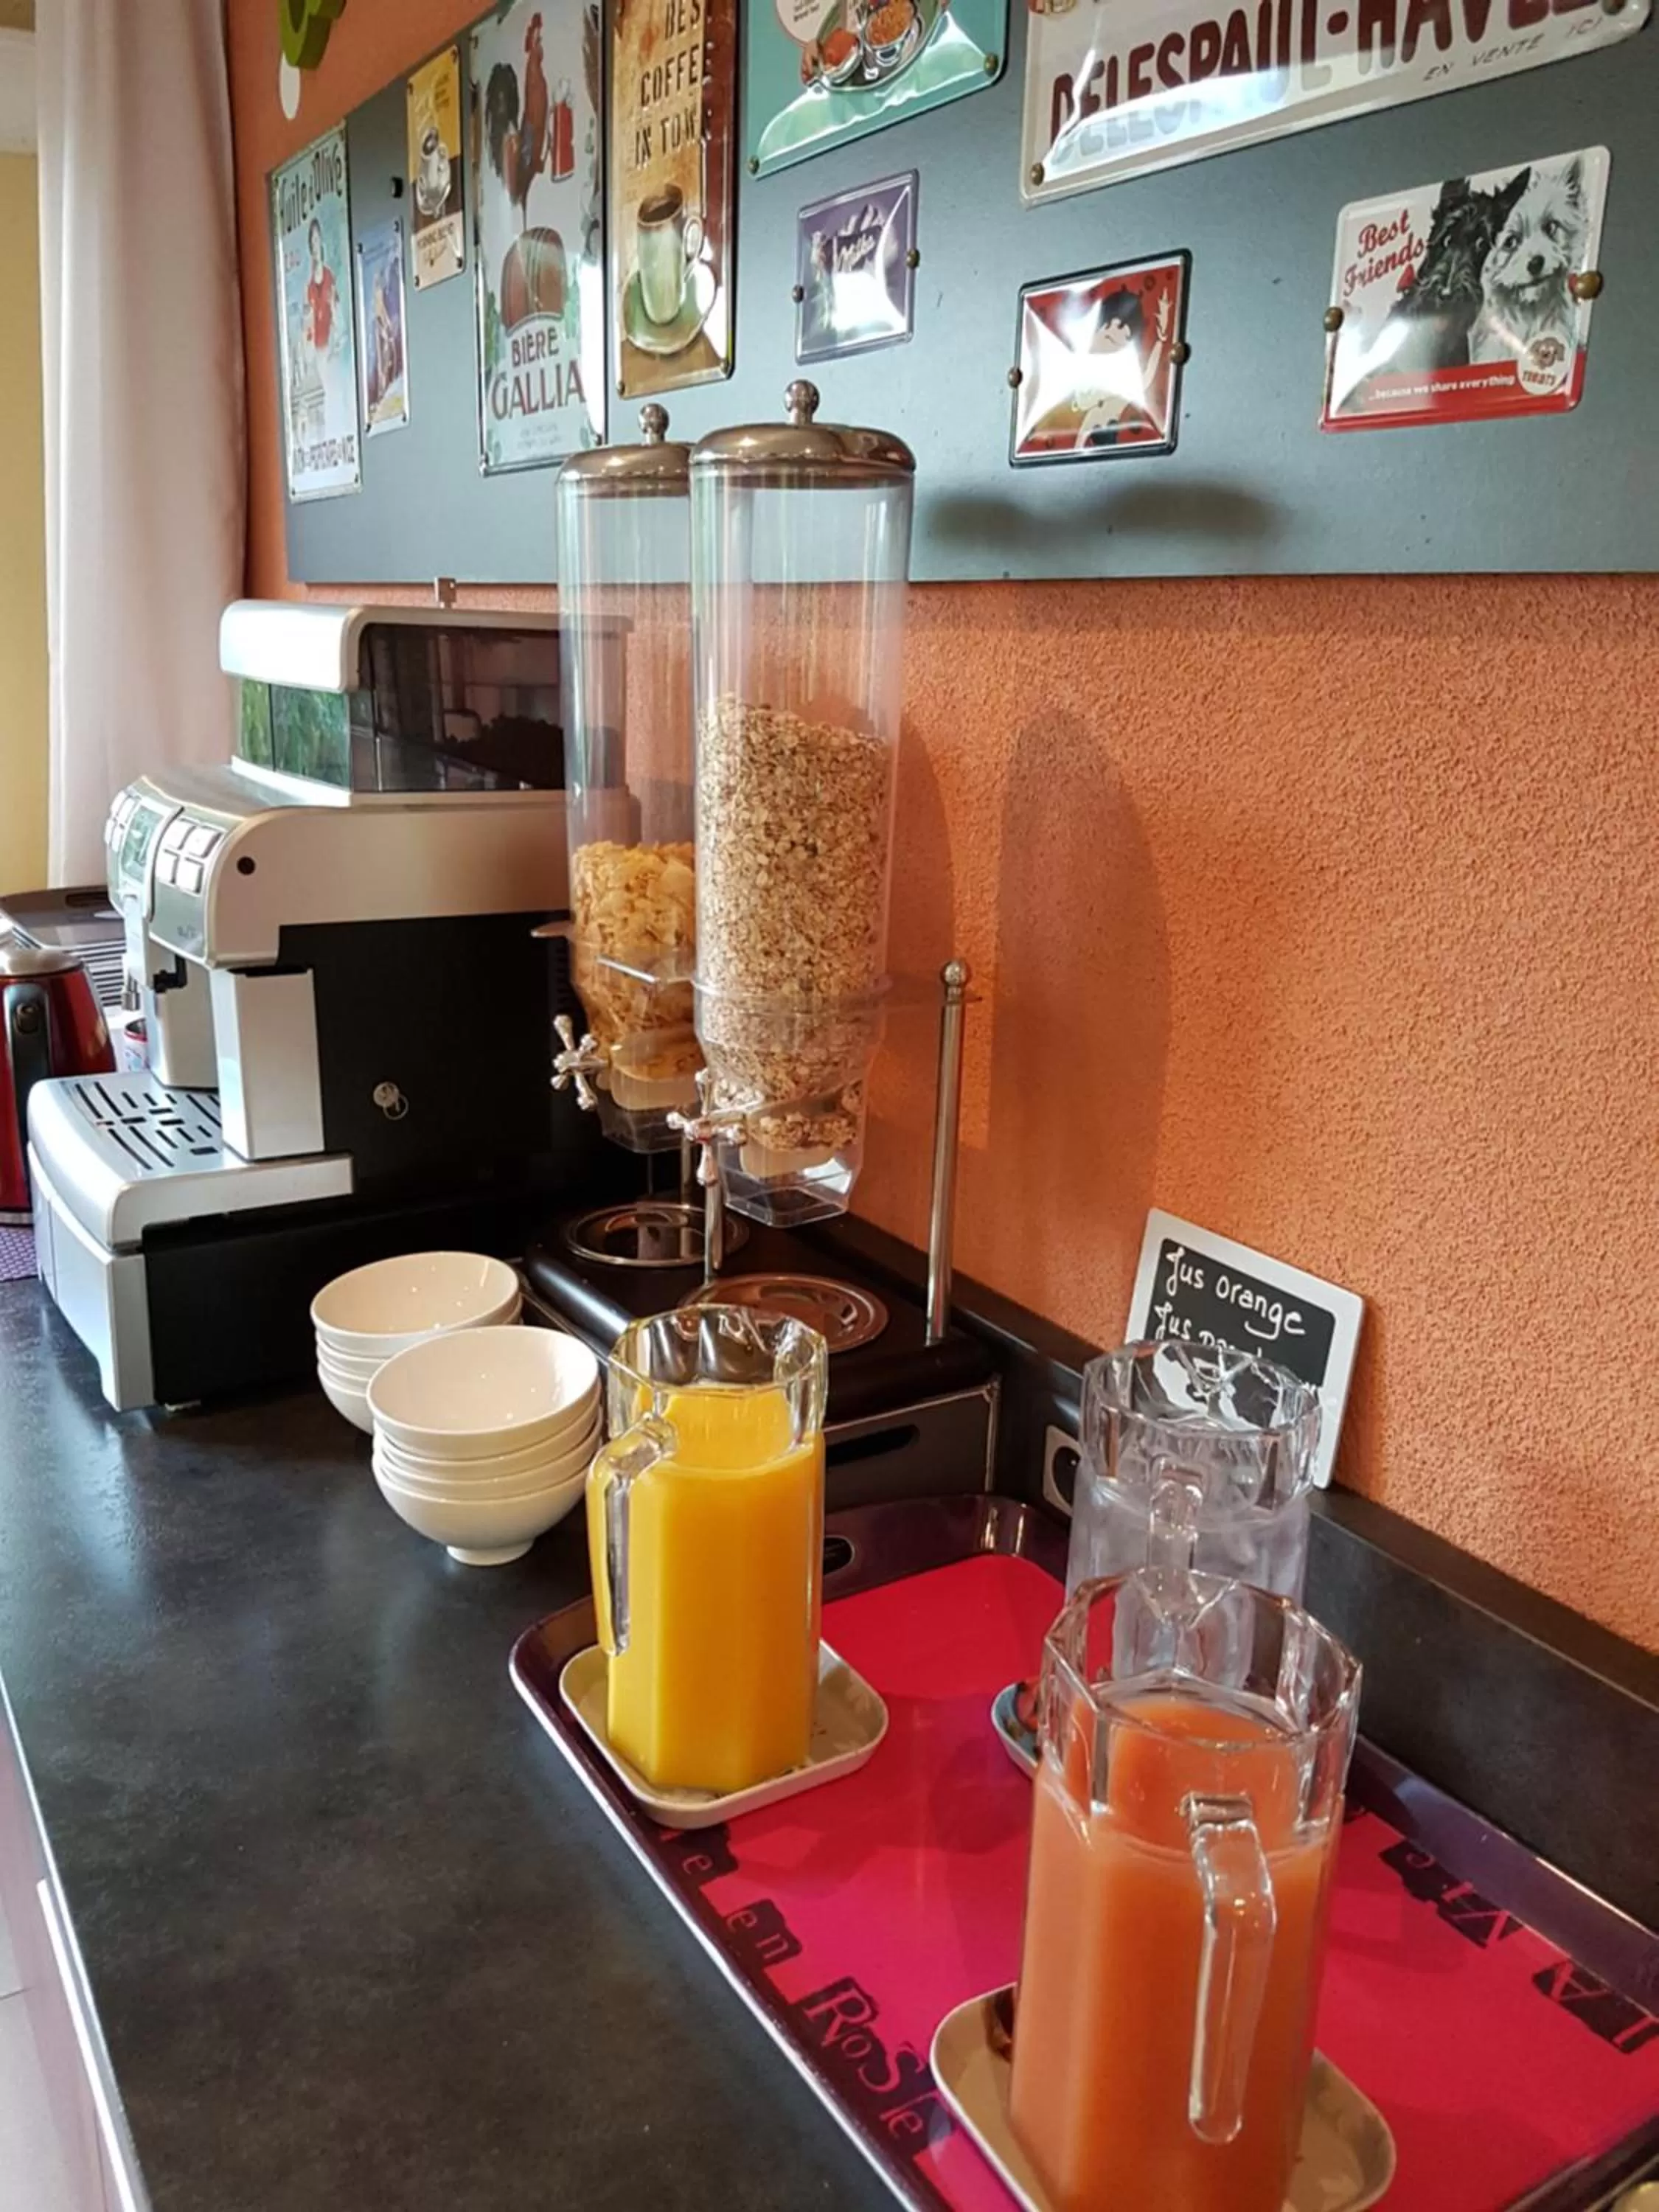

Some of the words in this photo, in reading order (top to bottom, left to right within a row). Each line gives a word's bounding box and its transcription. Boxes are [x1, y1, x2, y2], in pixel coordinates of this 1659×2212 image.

[640, 44, 703, 107] COFFE
[1423, 63, 1455, 81] EN
[1472, 33, 1545, 66] VENTE
[1568, 16, 1603, 39] ICI
[636, 125, 651, 167] IN
[661, 107, 703, 154] TOW
[1343, 232, 1425, 296] Friends
[1357, 209, 1410, 259] Best
[512, 325, 560, 367] BIÈRE
[491, 359, 587, 421] GALLIA
[1430, 380, 1456, 393] share
[1459, 374, 1515, 390] everything
